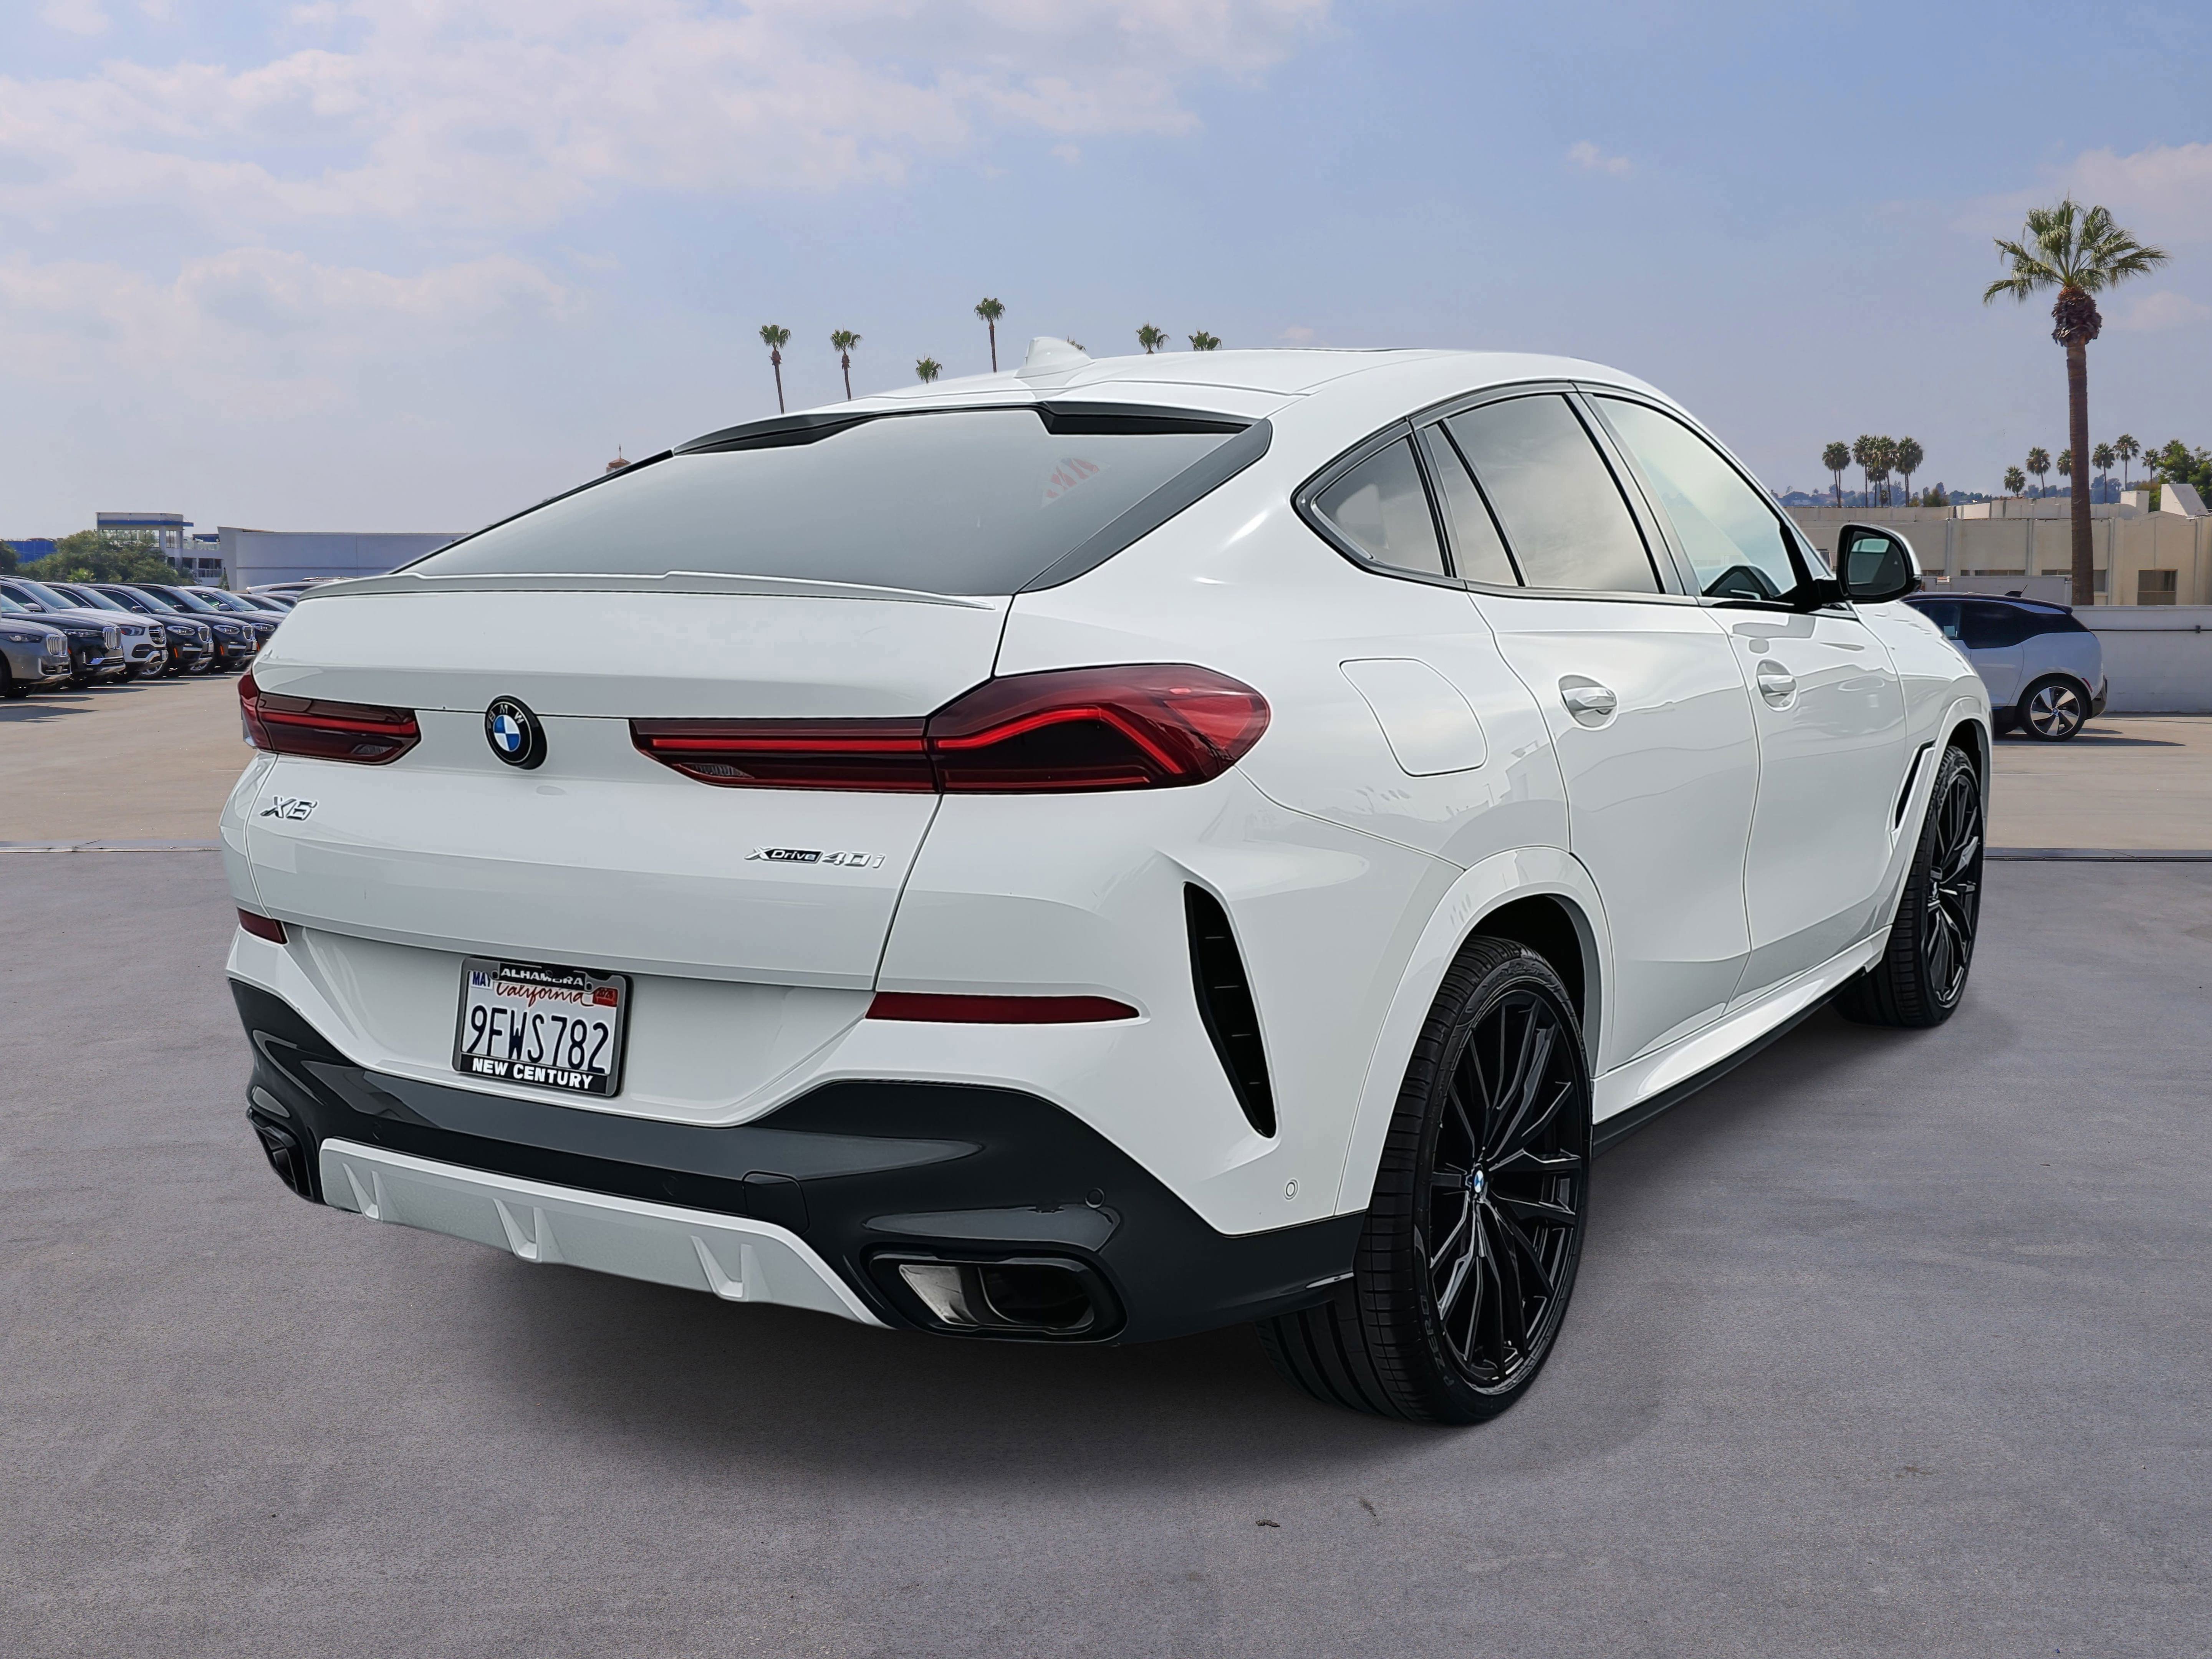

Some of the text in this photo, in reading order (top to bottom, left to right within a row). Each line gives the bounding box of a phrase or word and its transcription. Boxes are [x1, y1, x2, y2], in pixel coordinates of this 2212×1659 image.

[488, 704, 524, 724] BMW
[260, 796, 318, 821] X6
[823, 851, 886, 869] 40i
[466, 1005, 609, 1074] 9FWS782
[472, 1058, 593, 1089] NEW CENTURY
